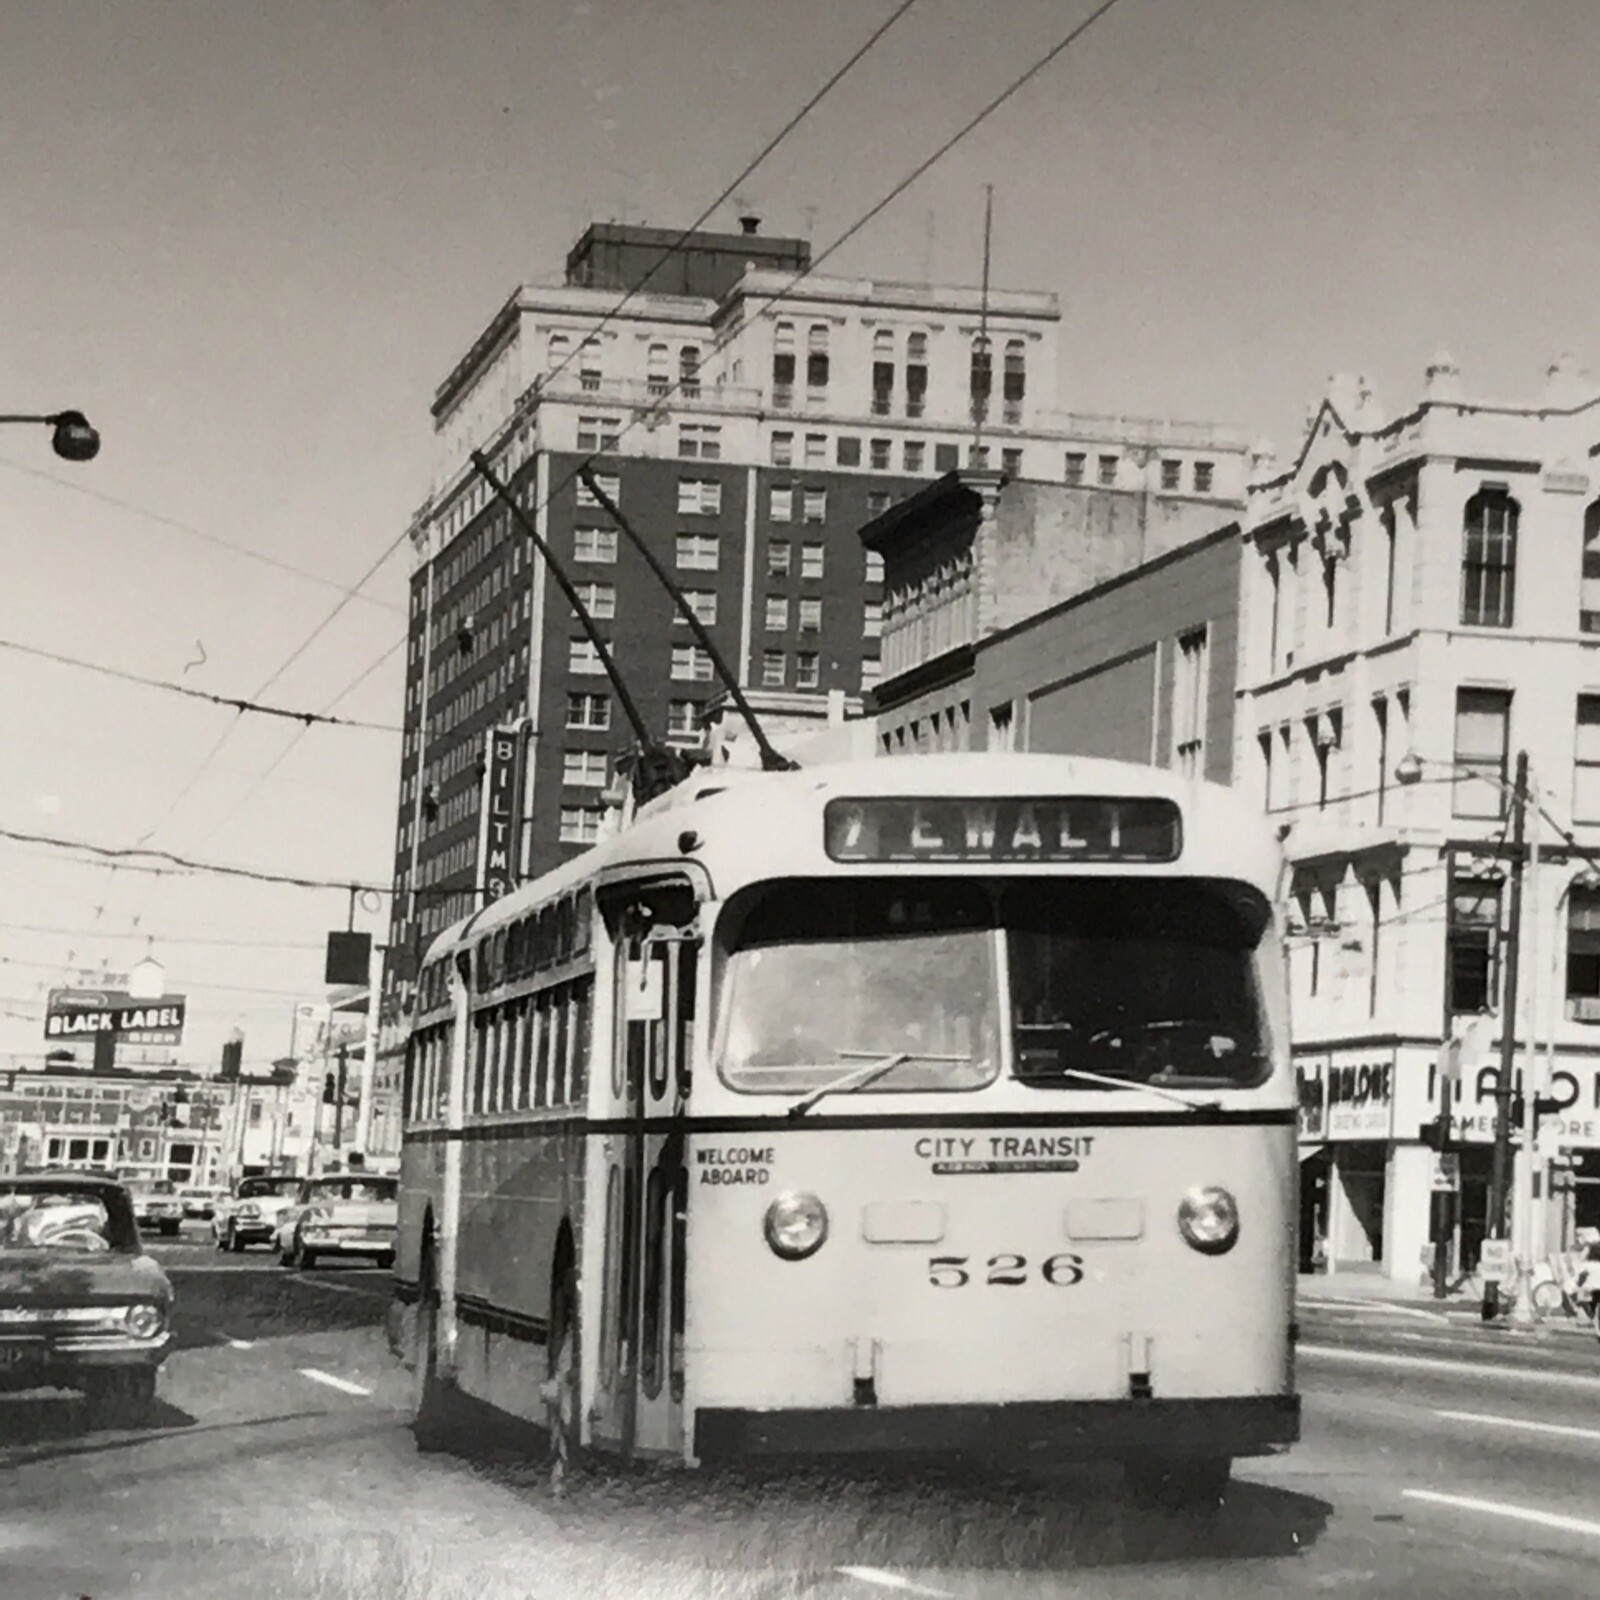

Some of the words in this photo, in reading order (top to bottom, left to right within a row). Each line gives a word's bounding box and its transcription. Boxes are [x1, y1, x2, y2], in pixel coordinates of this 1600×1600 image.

[48, 1012, 113, 1035] BLACK
[121, 1007, 181, 1029] LABEL
[696, 1147, 775, 1165] WELCOME
[914, 1137, 976, 1159] CITY
[989, 1135, 1096, 1157] TRANSIT
[700, 1168, 770, 1186] ABOARD
[928, 1253, 1085, 1288] 526
